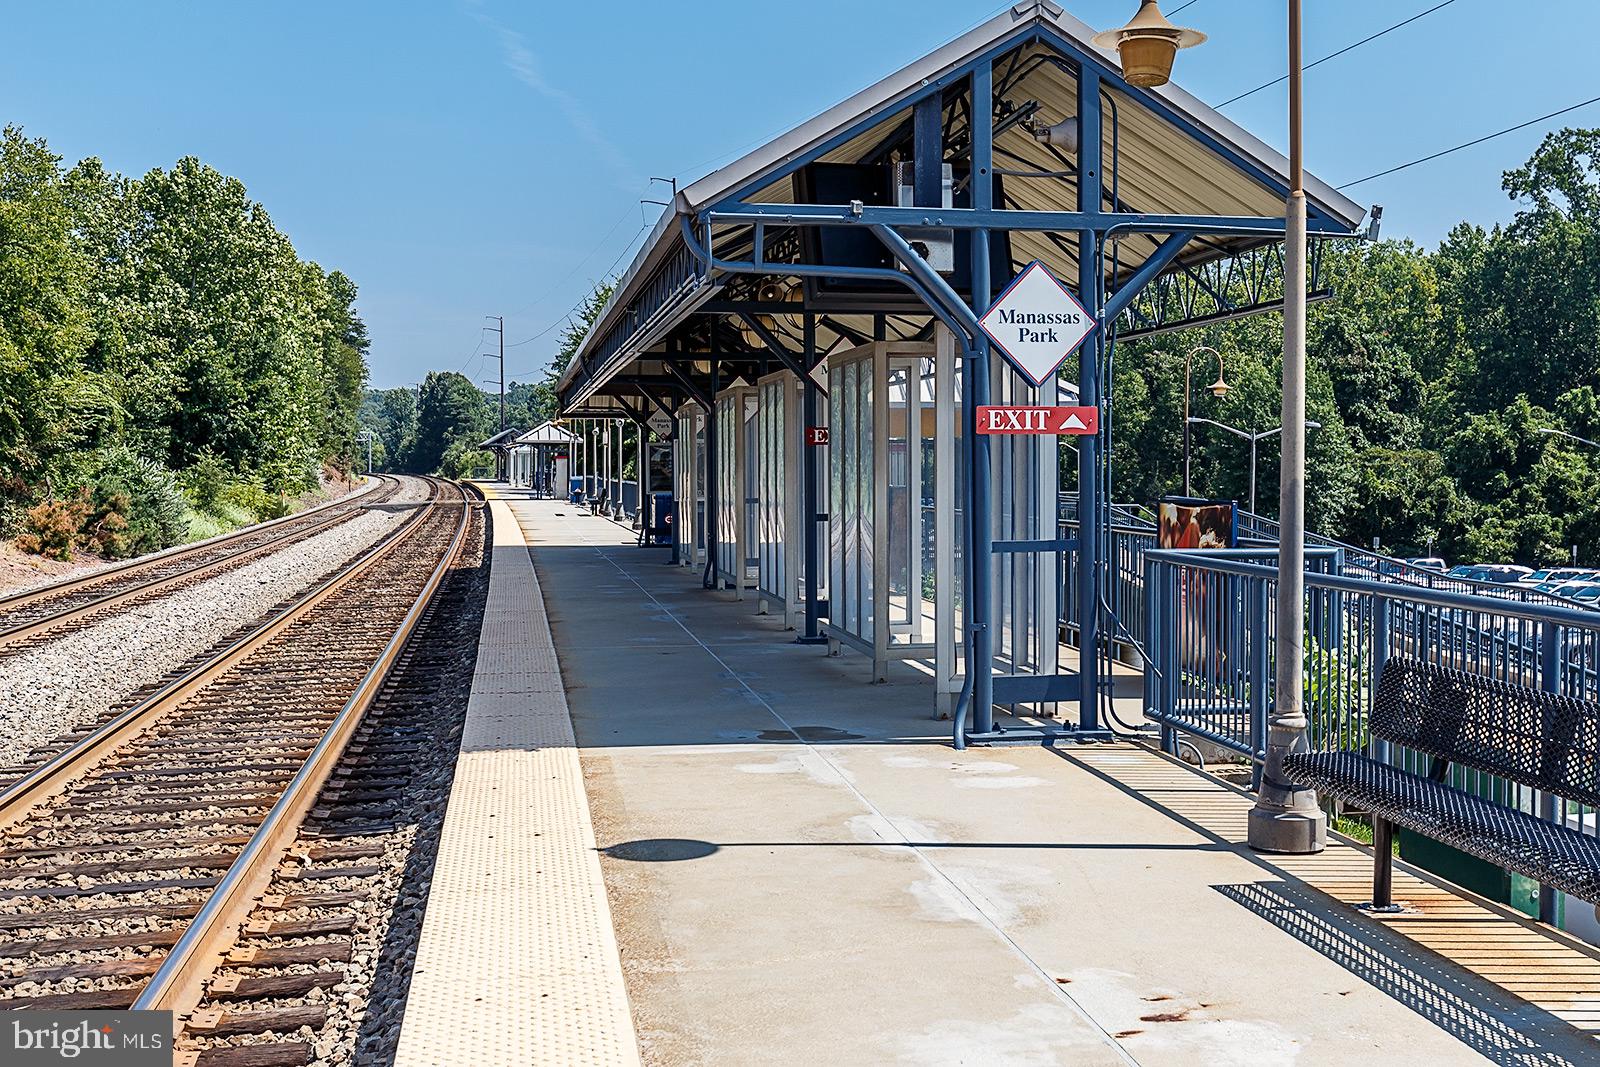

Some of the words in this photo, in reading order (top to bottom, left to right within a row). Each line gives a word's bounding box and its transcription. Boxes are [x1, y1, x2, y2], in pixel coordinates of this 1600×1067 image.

[998, 309, 1080, 324] Manassas
[1018, 327, 1059, 343] Park
[988, 410, 1050, 430] EXIT
